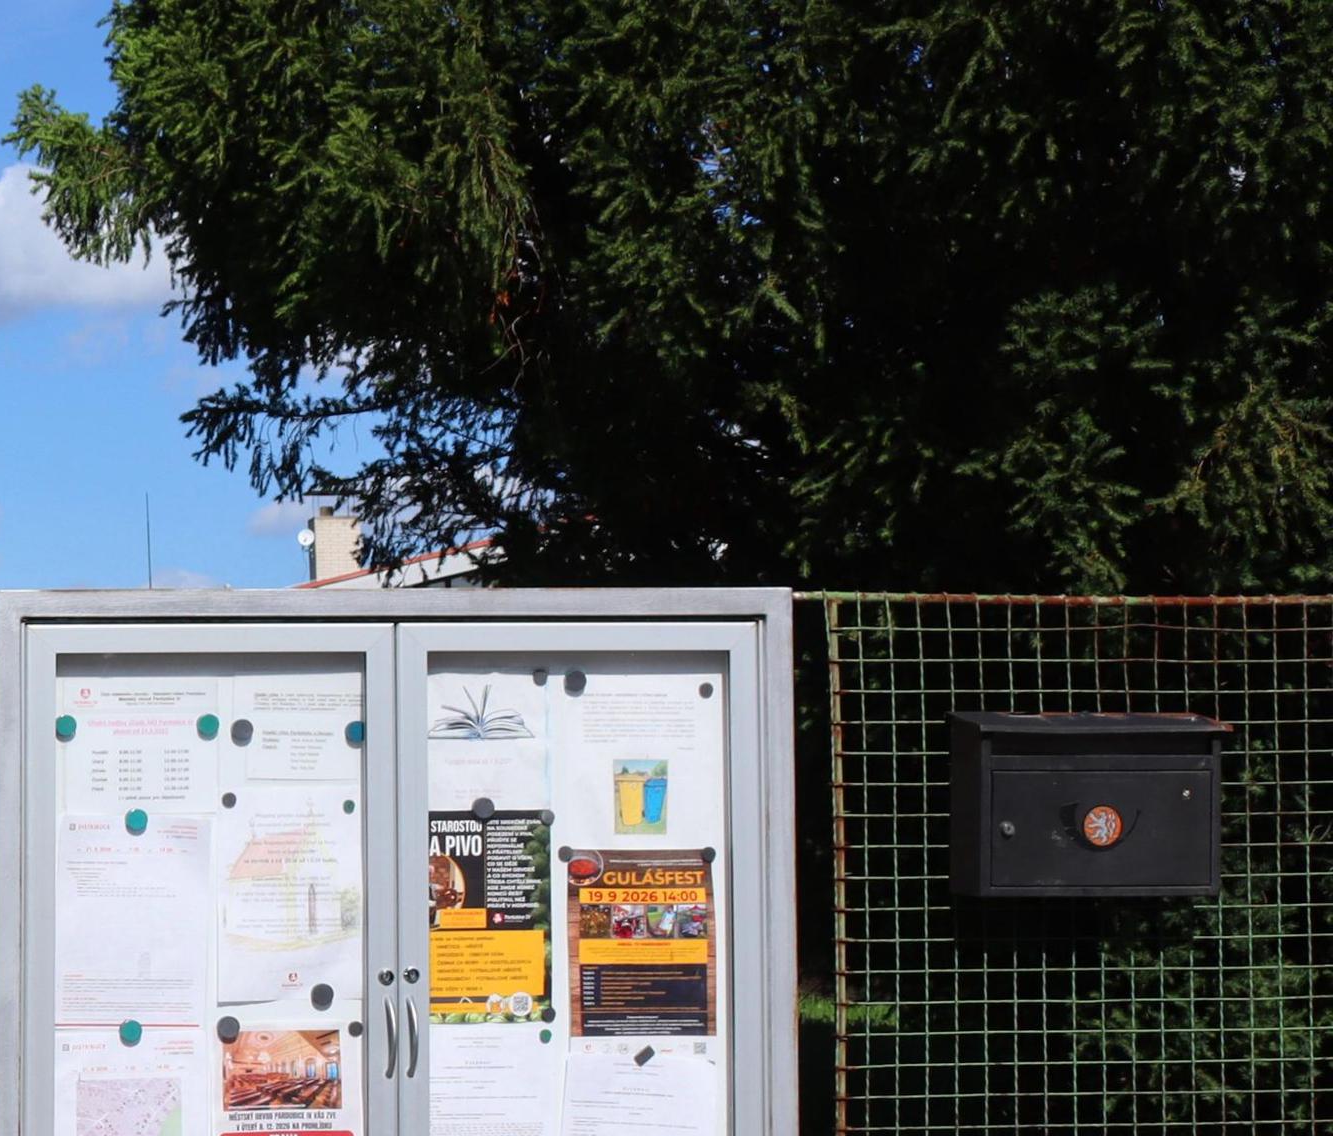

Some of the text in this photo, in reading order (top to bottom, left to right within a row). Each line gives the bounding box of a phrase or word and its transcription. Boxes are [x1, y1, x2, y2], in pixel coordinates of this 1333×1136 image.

[431, 820, 482, 832] STAROSTOU
[445, 835, 482, 856] PIVO
[603, 868, 704, 885] GULÁŠFEST
[589, 891, 603, 902] 19
[622, 891, 658, 902] 2026
[664, 891, 698, 902] 14:00
